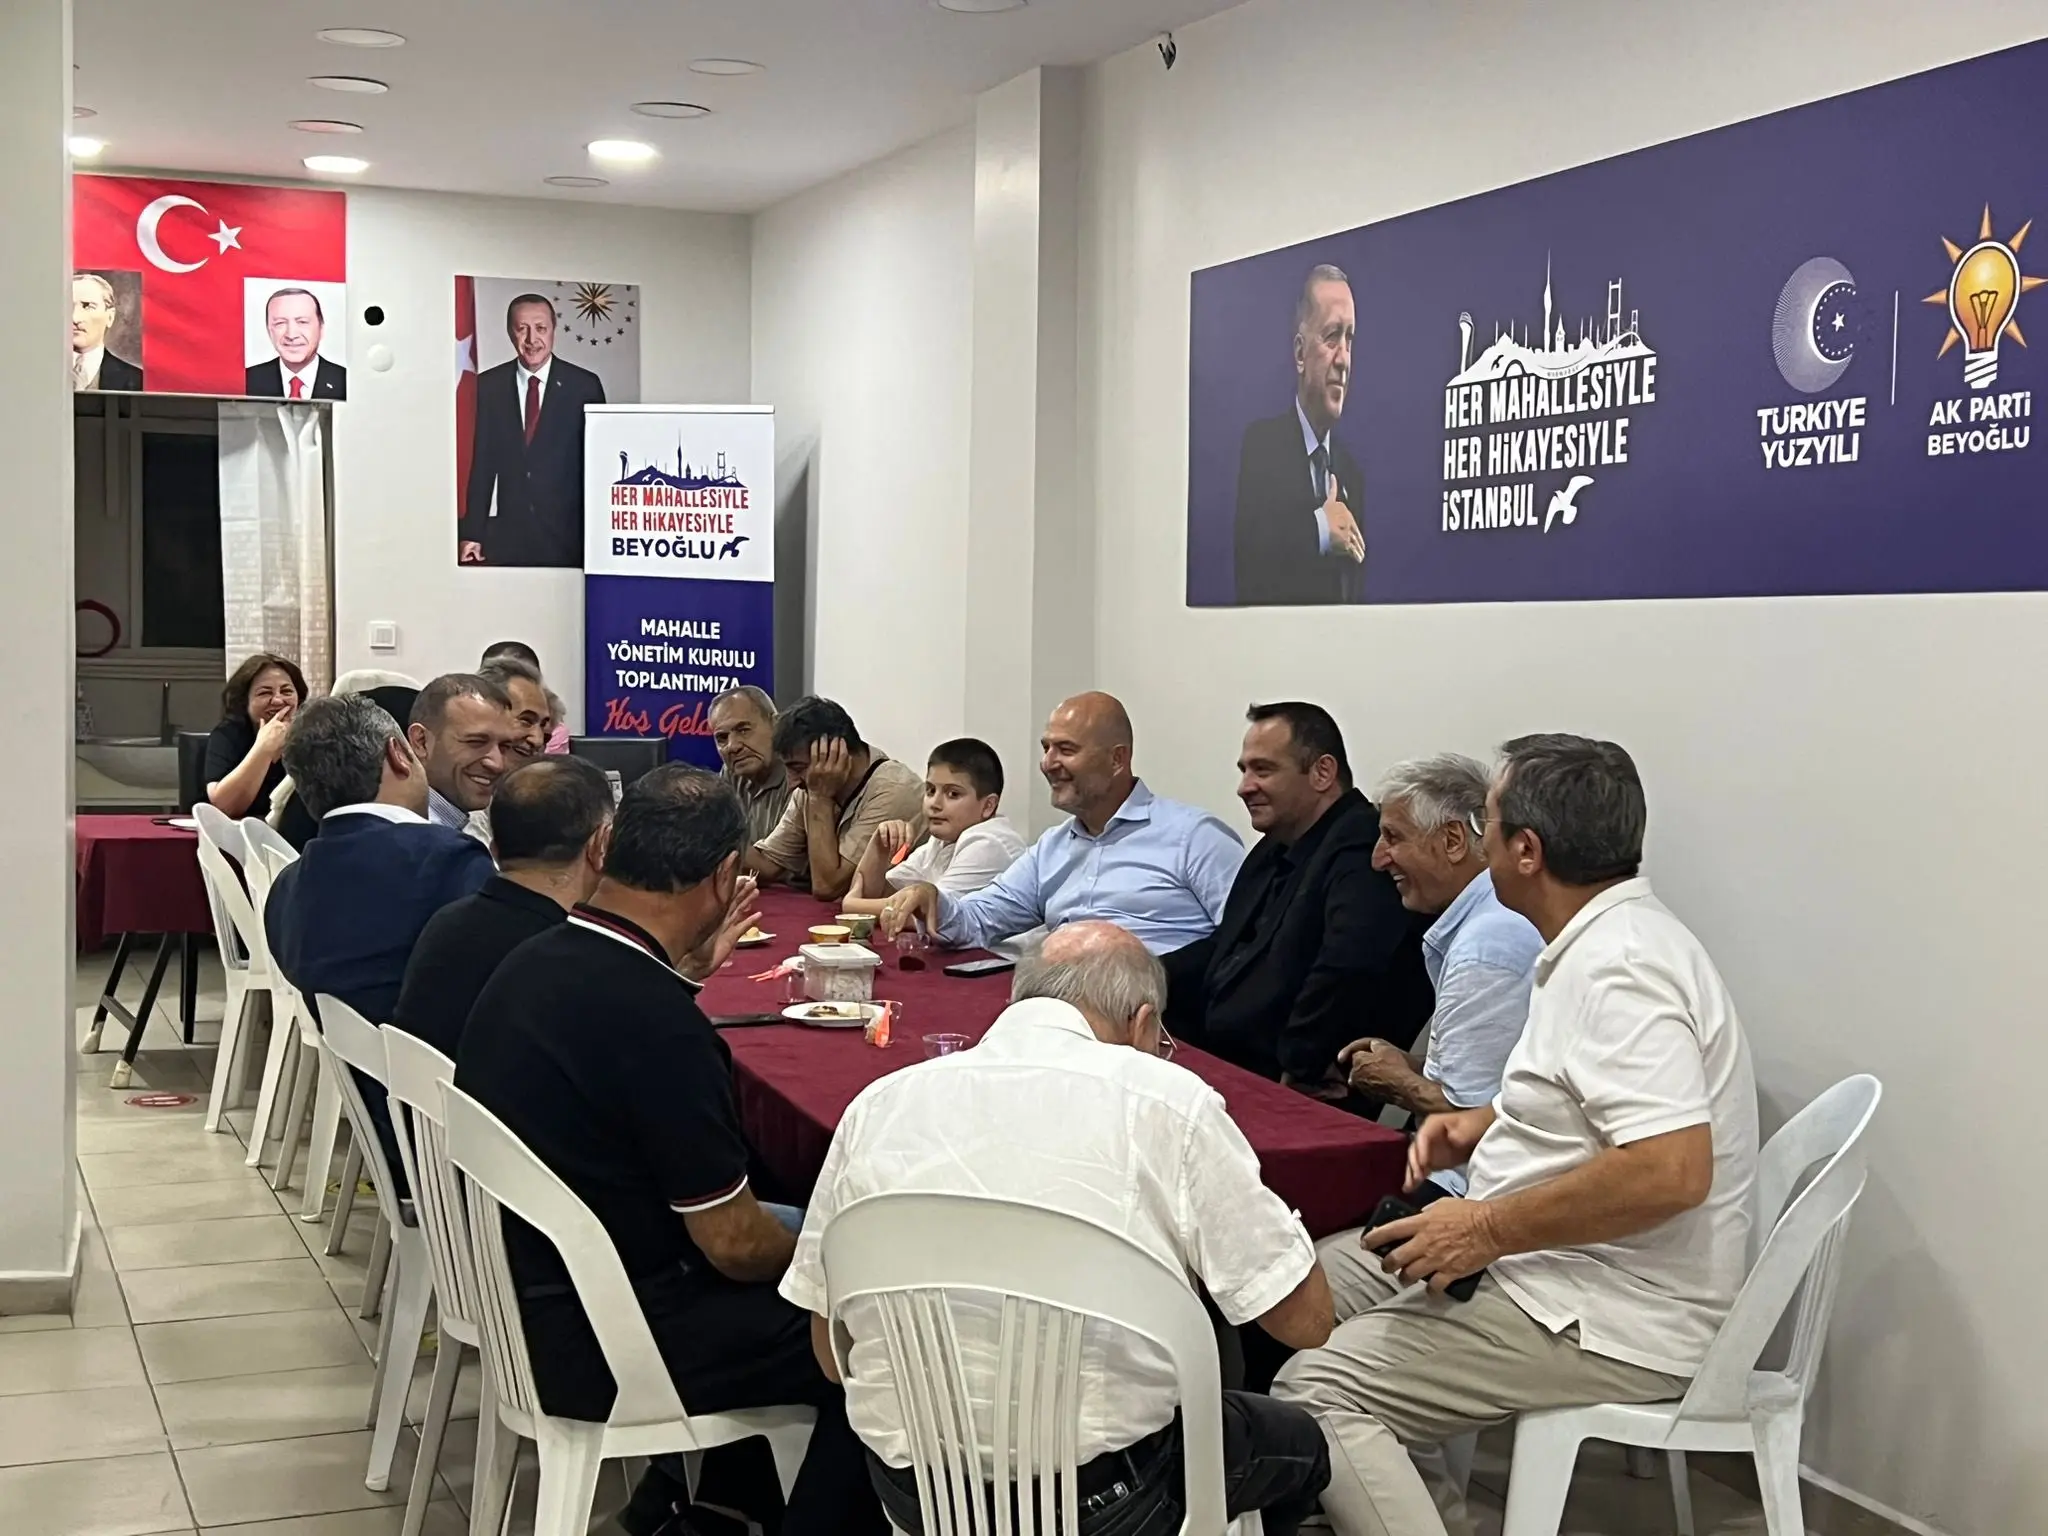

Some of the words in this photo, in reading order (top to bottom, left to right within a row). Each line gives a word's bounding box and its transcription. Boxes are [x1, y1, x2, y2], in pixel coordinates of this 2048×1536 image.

[1445, 384, 1483, 429] HER
[1929, 399, 1963, 426] AK
[1927, 424, 2030, 456] BEYOĞLU
[1443, 436, 1481, 480] HER
[611, 486, 638, 506] HER
[611, 510, 638, 531] HER
[612, 536, 715, 559] BEYOĞLU
[641, 618, 721, 640] MAHALLE
[607, 640, 684, 665] YÖNETİM
[688, 647, 756, 669] KURULU
[615, 669, 740, 694] TOPLANTIMIZA
[603, 696, 652, 737] Hoş
